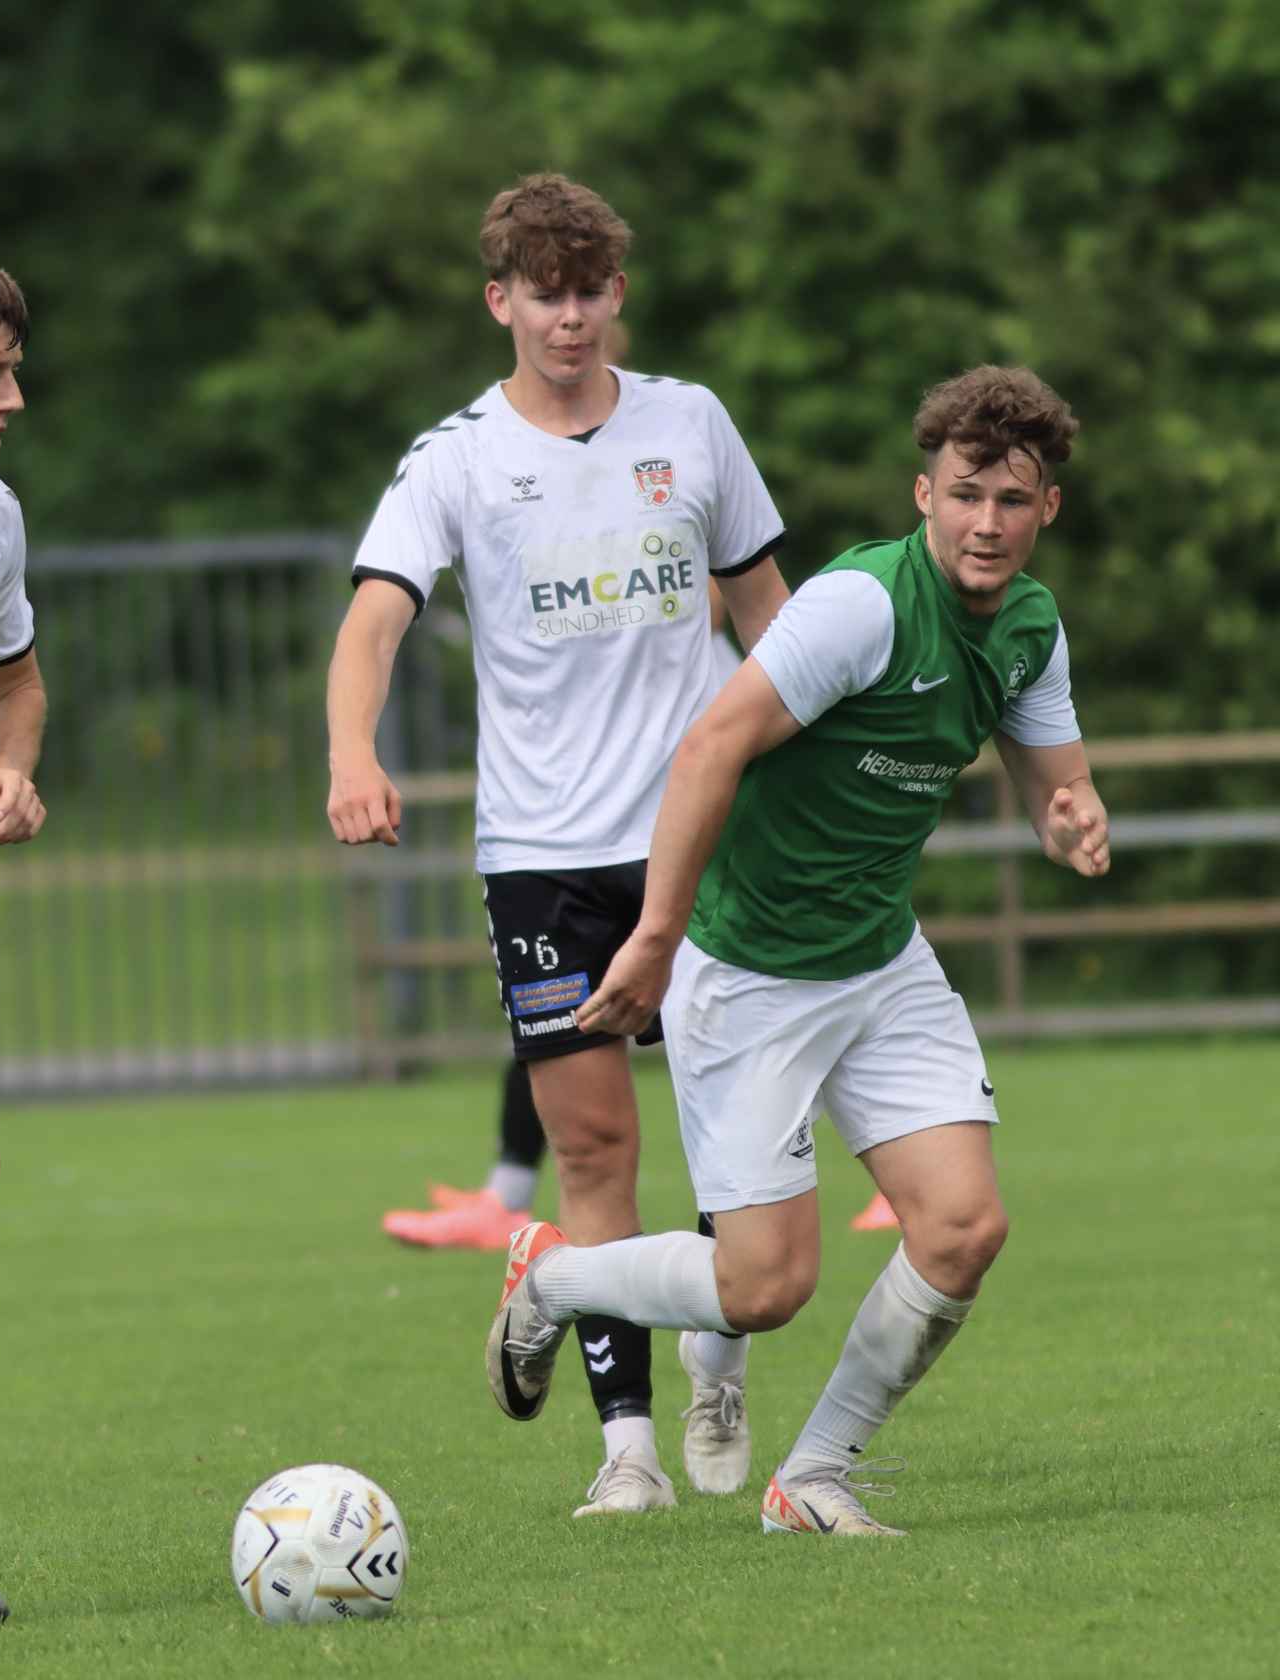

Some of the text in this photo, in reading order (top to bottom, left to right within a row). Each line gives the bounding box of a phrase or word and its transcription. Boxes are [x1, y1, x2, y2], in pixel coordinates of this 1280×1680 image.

[637, 463, 669, 471] VIF
[530, 559, 693, 613] EMCARE
[536, 605, 645, 638] SUNDHED
[519, 1010, 577, 1037] hummel
[329, 1489, 354, 1538] hummel
